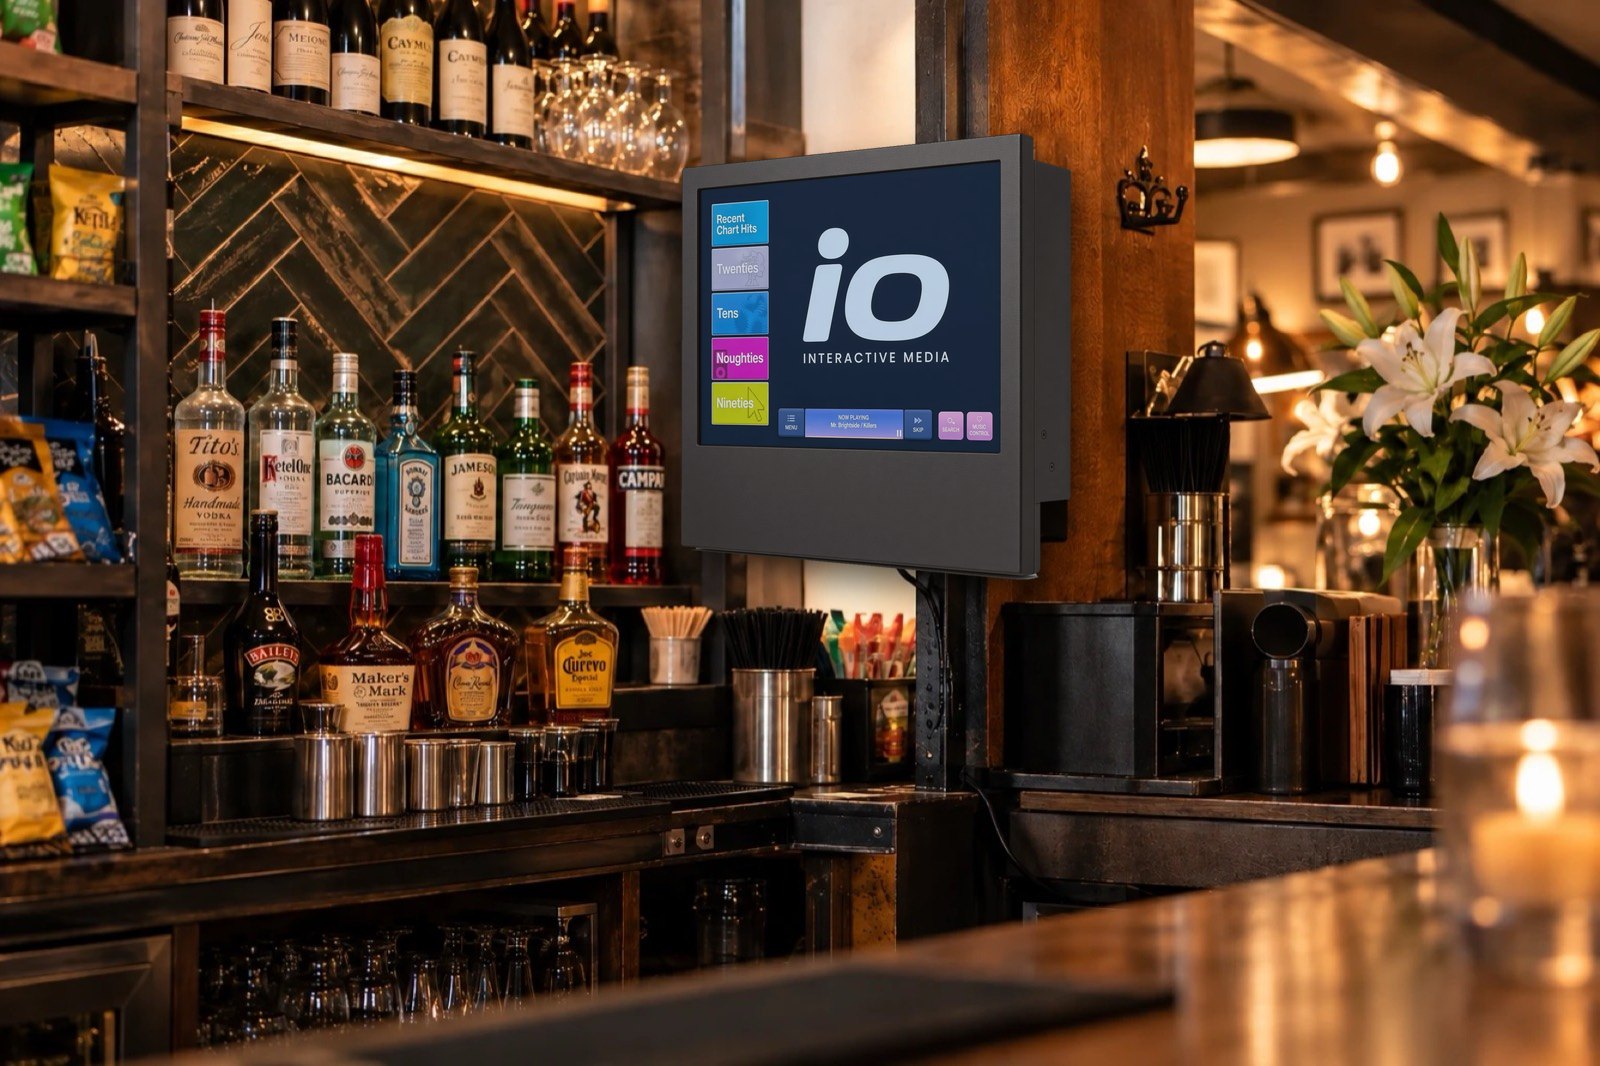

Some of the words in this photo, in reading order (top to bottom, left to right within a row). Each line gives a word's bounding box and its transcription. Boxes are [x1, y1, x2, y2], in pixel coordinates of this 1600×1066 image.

[716, 213, 745, 224] Recent
[716, 225, 739, 235] Chart
[741, 223, 757, 234] Hits
[716, 262, 759, 275] Twenties
[802, 227, 950, 342] io
[717, 307, 739, 319] Tens
[716, 352, 764, 366] Noughties
[803, 352, 896, 364] INTERACTIVE
[903, 351, 950, 363] MEDIA
[716, 397, 754, 409] Nineties
[189, 435, 239, 456] Tito's
[196, 512, 231, 520] VODKA
[351, 672, 409, 684] Maker's
[369, 685, 406, 697] Mark
